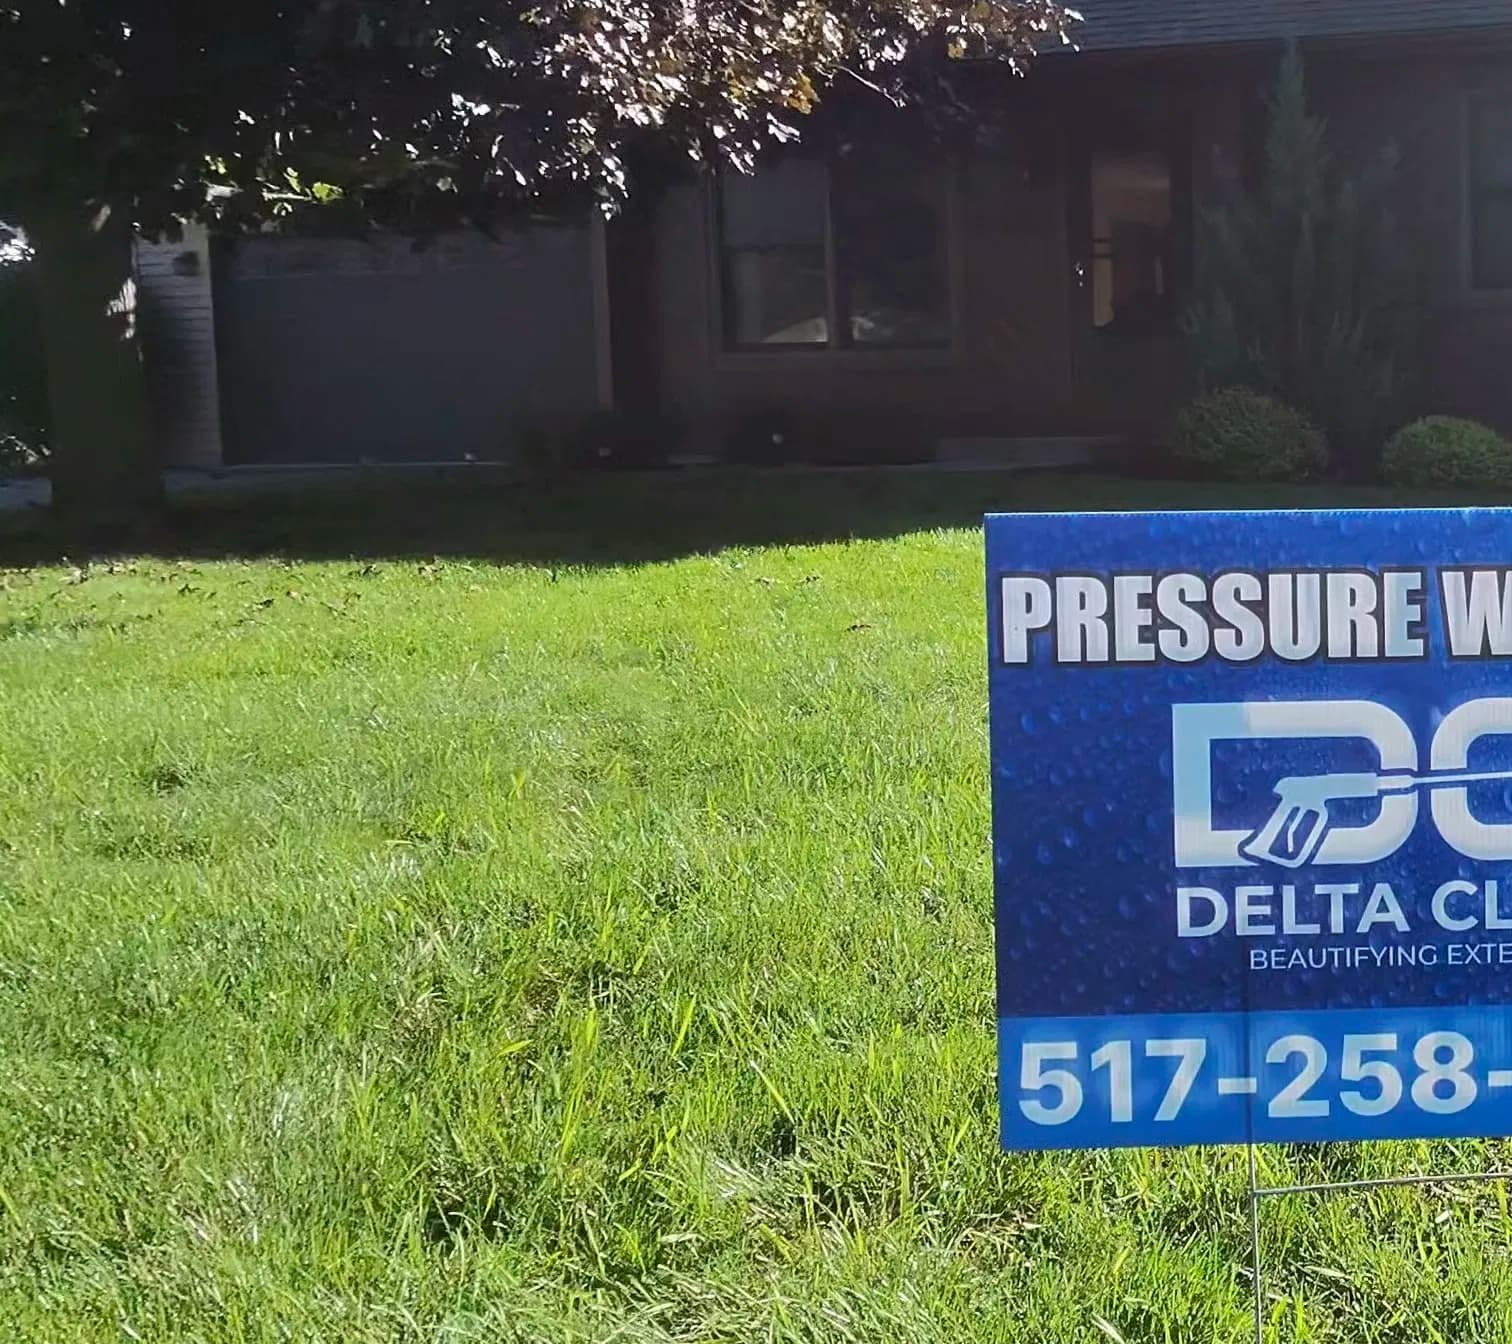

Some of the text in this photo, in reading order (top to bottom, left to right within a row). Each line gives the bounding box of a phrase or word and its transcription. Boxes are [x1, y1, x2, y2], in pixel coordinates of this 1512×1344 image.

[1001, 570, 1426, 664] PRESSURE
[1176, 882, 1411, 939] DELTA
[1249, 946, 1438, 971] BEAUTIFYING
